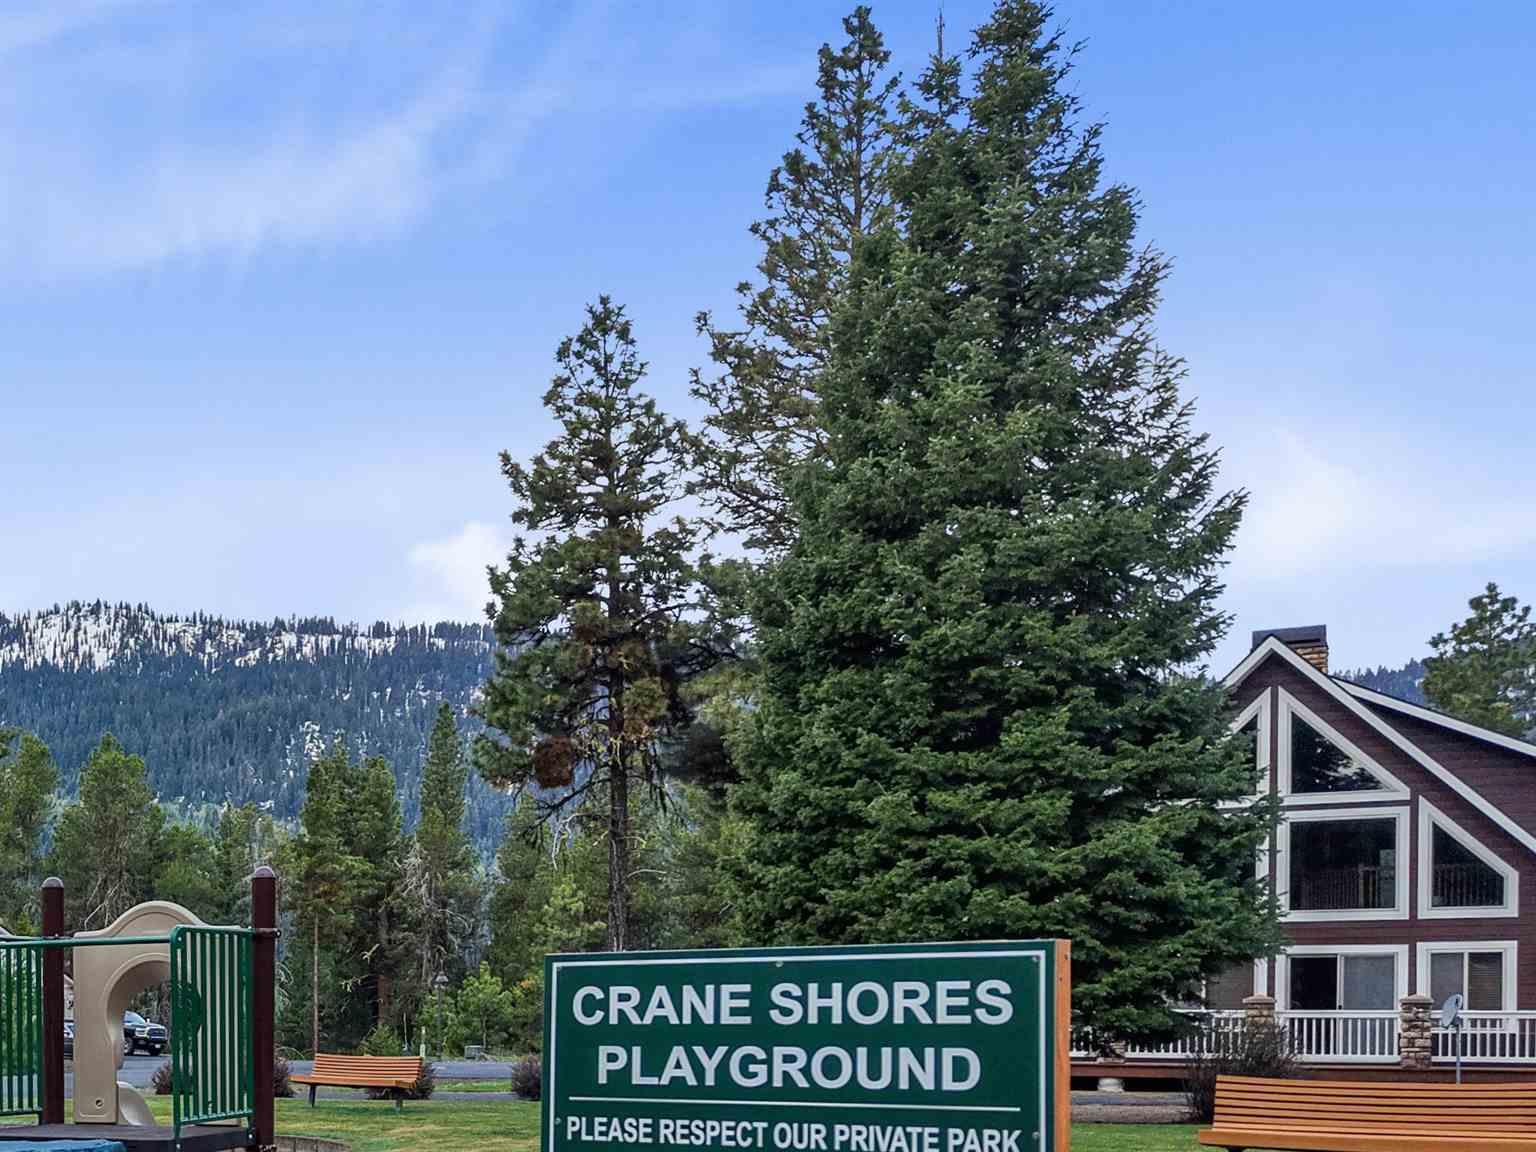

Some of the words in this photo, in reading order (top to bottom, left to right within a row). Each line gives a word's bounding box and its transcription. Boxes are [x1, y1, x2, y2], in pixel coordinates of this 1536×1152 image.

[573, 984, 751, 1025] CRANE
[770, 980, 1013, 1024] SHORES
[598, 1046, 980, 1090] PLAYGROUND
[567, 1117, 652, 1143] PLEASE
[660, 1119, 768, 1147] RESPECT
[774, 1123, 827, 1149] OUR
